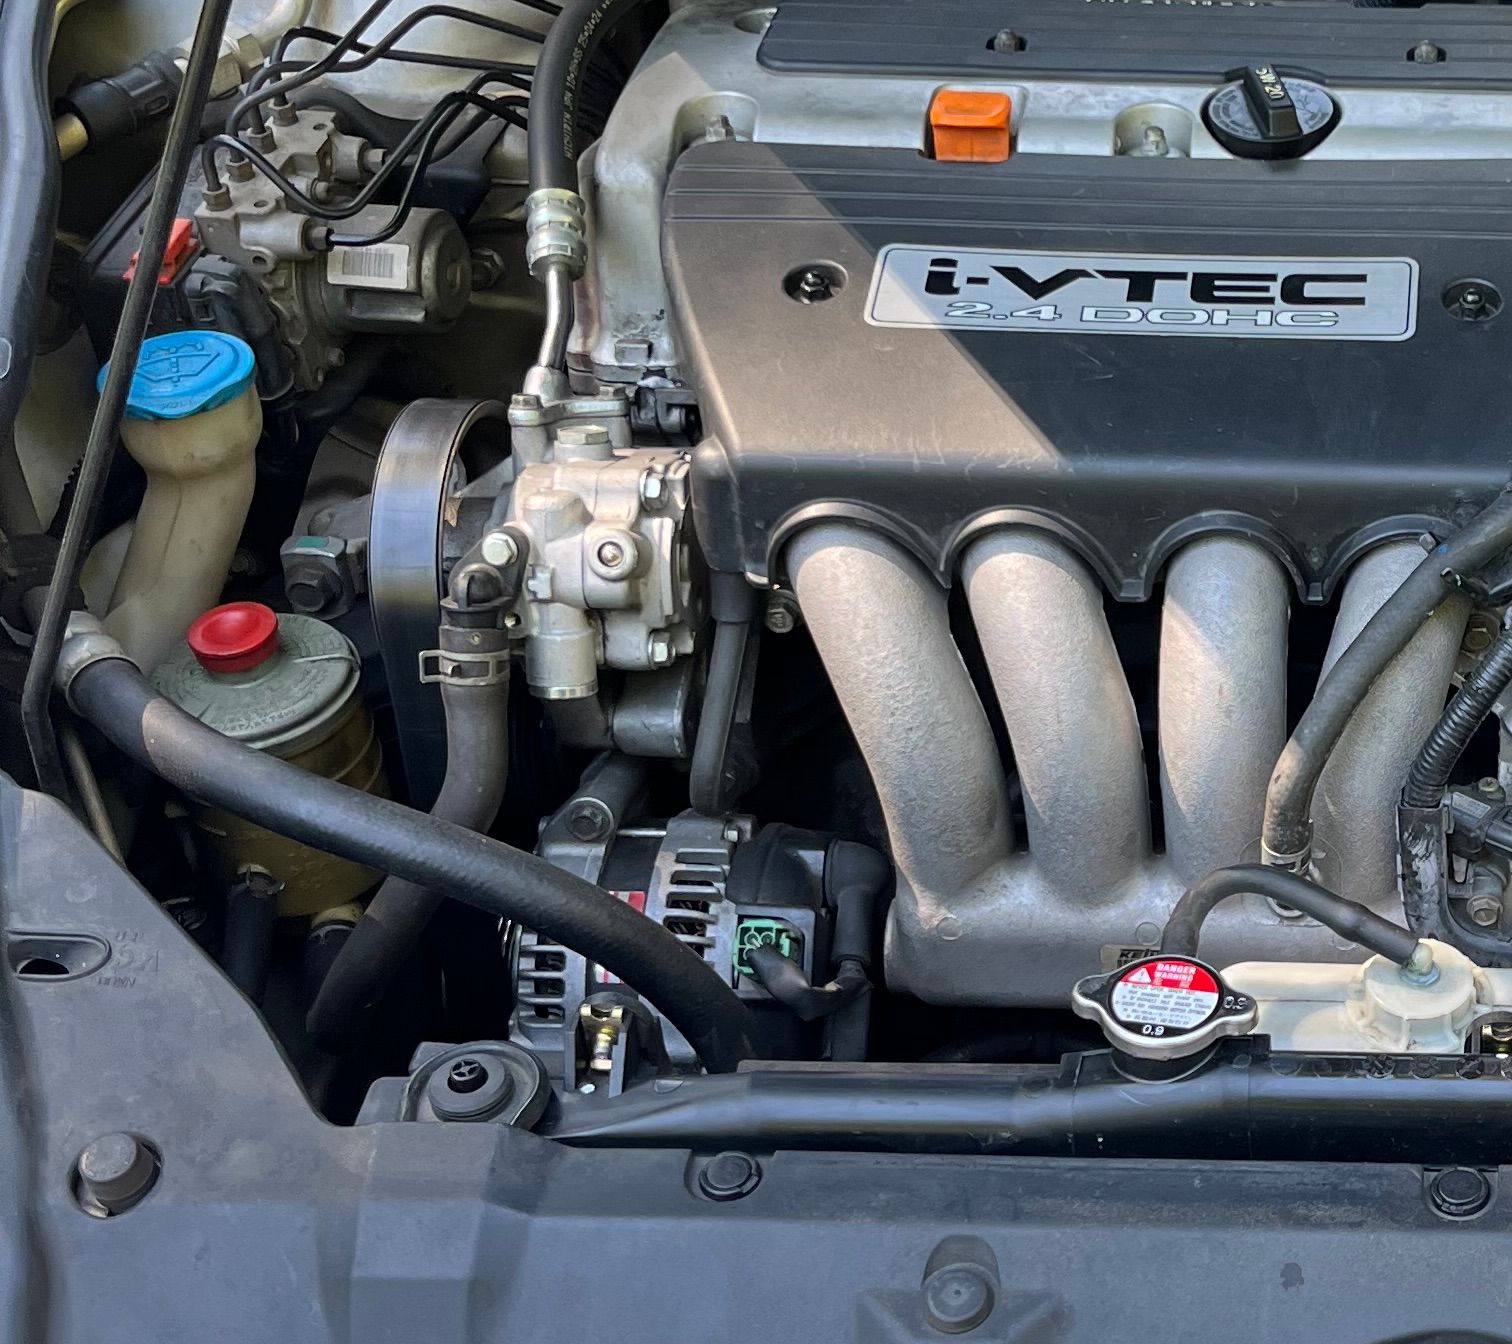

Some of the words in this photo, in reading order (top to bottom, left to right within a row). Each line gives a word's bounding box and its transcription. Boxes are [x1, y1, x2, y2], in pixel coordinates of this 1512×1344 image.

[924, 258, 1368, 306] i-VTEC
[945, 301, 1062, 322] 2.4
[1080, 305, 1339, 328] DOHC
[1155, 962, 1198, 975] DANGER
[1141, 1023, 1166, 1036] 0.9
